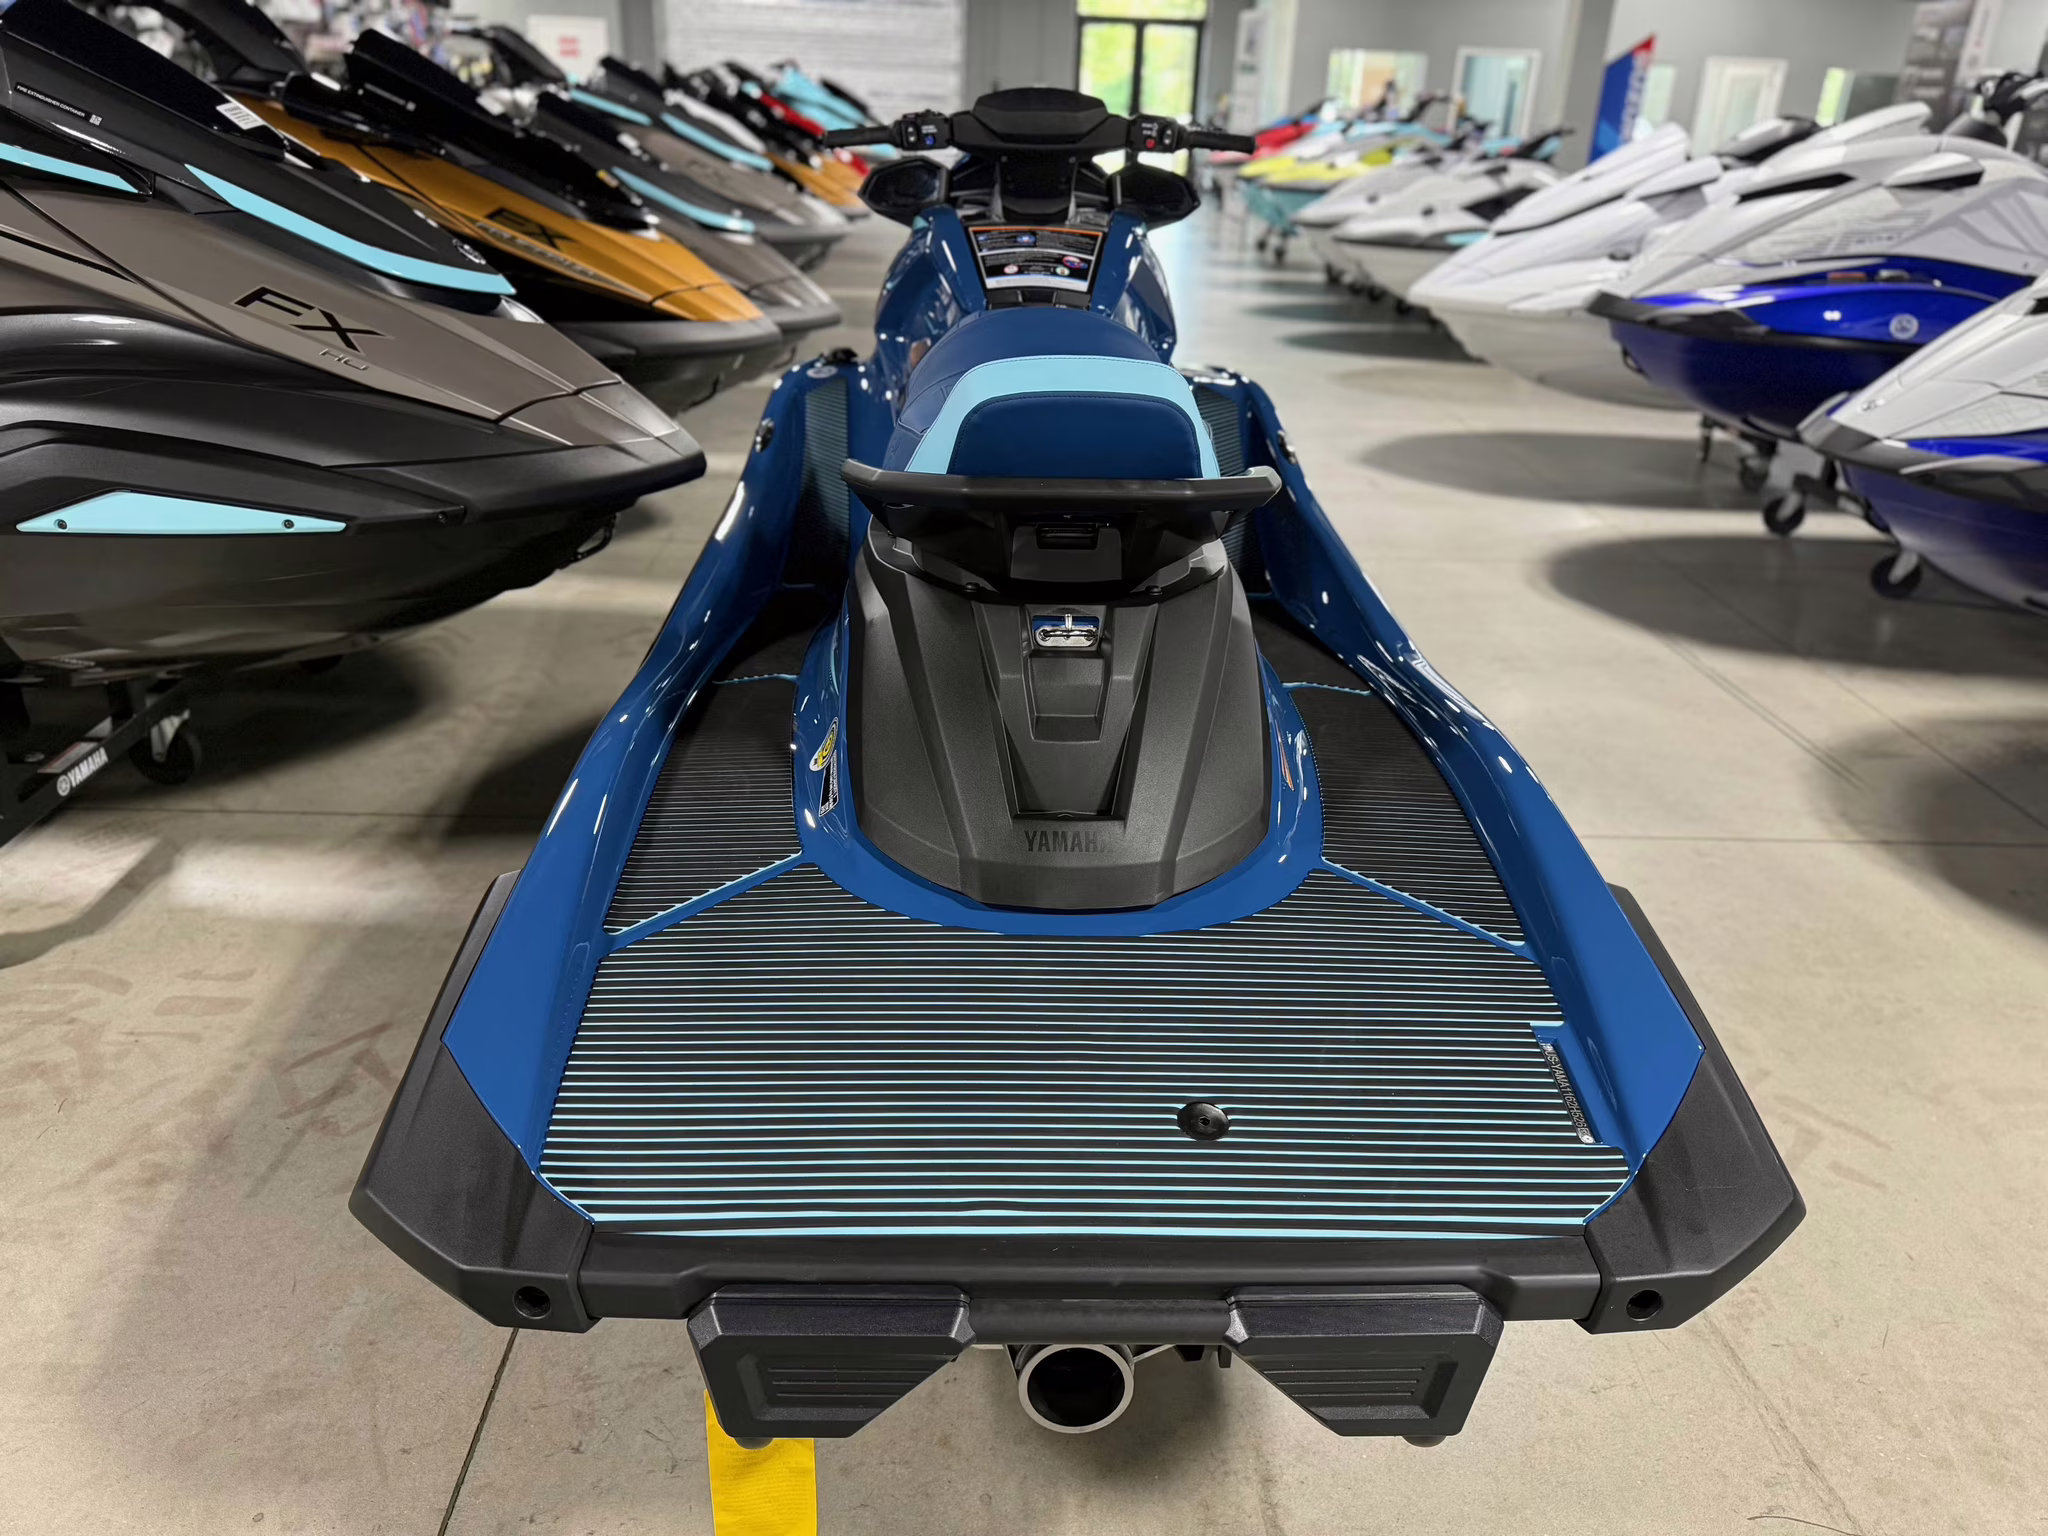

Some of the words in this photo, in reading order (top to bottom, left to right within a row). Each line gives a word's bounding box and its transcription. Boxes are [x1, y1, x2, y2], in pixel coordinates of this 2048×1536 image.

[16, 85, 28, 93] FIRE
[27, 89, 60, 107] EXTINGUISHER
[59, 103, 86, 118] CONTAINER
[484, 207, 580, 251] FX
[234, 286, 386, 353] FX
[67, 746, 109, 788] YAMAHA
[1023, 830, 1114, 853] YAMAH
